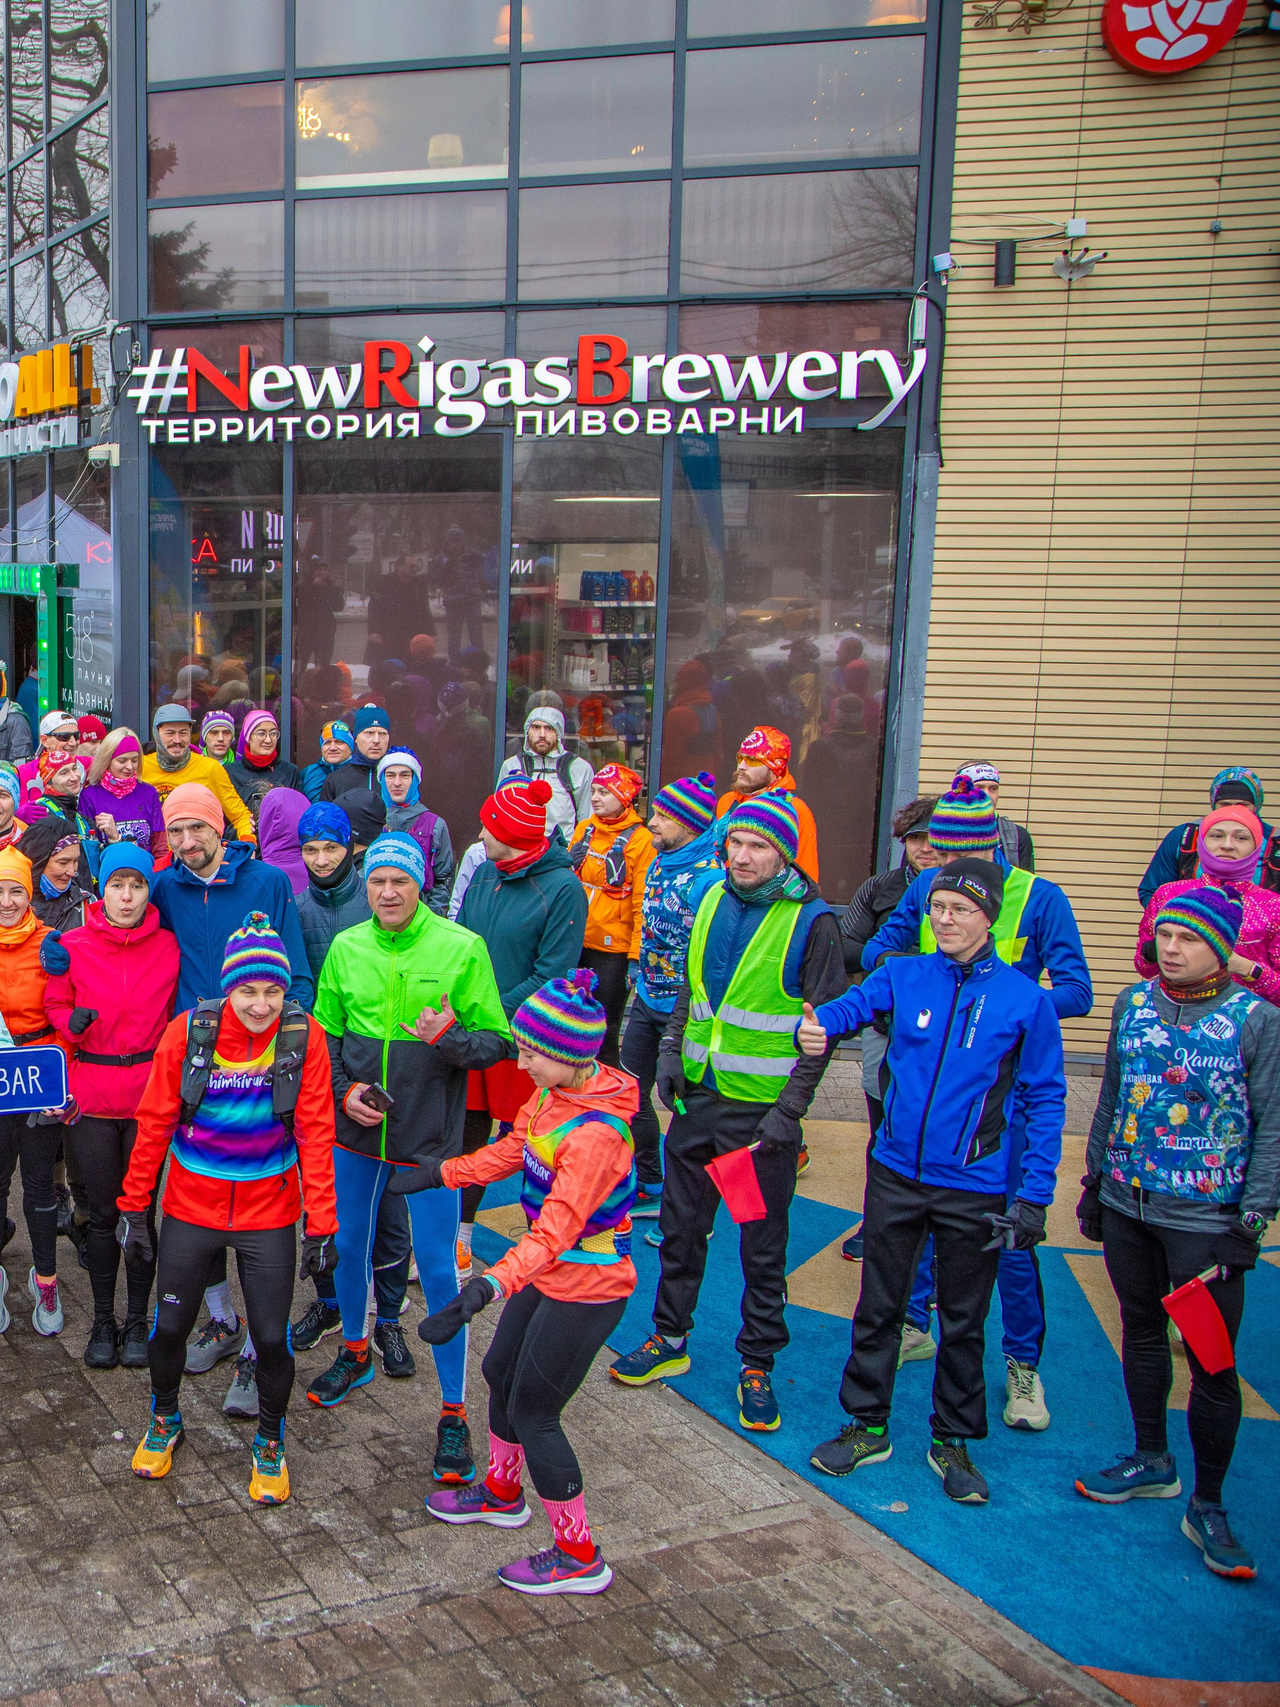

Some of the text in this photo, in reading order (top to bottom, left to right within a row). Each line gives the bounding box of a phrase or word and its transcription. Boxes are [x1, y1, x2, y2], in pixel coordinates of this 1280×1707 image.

[126, 334, 928, 438] #NewRigasBrewery
[141, 406, 804, 445] ТЕРРИТОРИЯ ПИВОВАРНИ
[77, 667, 112, 687] ЛАУНЖ
[62, 688, 113, 712] КАЛЬЯННАЯ
[965, 879, 988, 896] aws
[973, 994, 987, 1024] VICTORY
